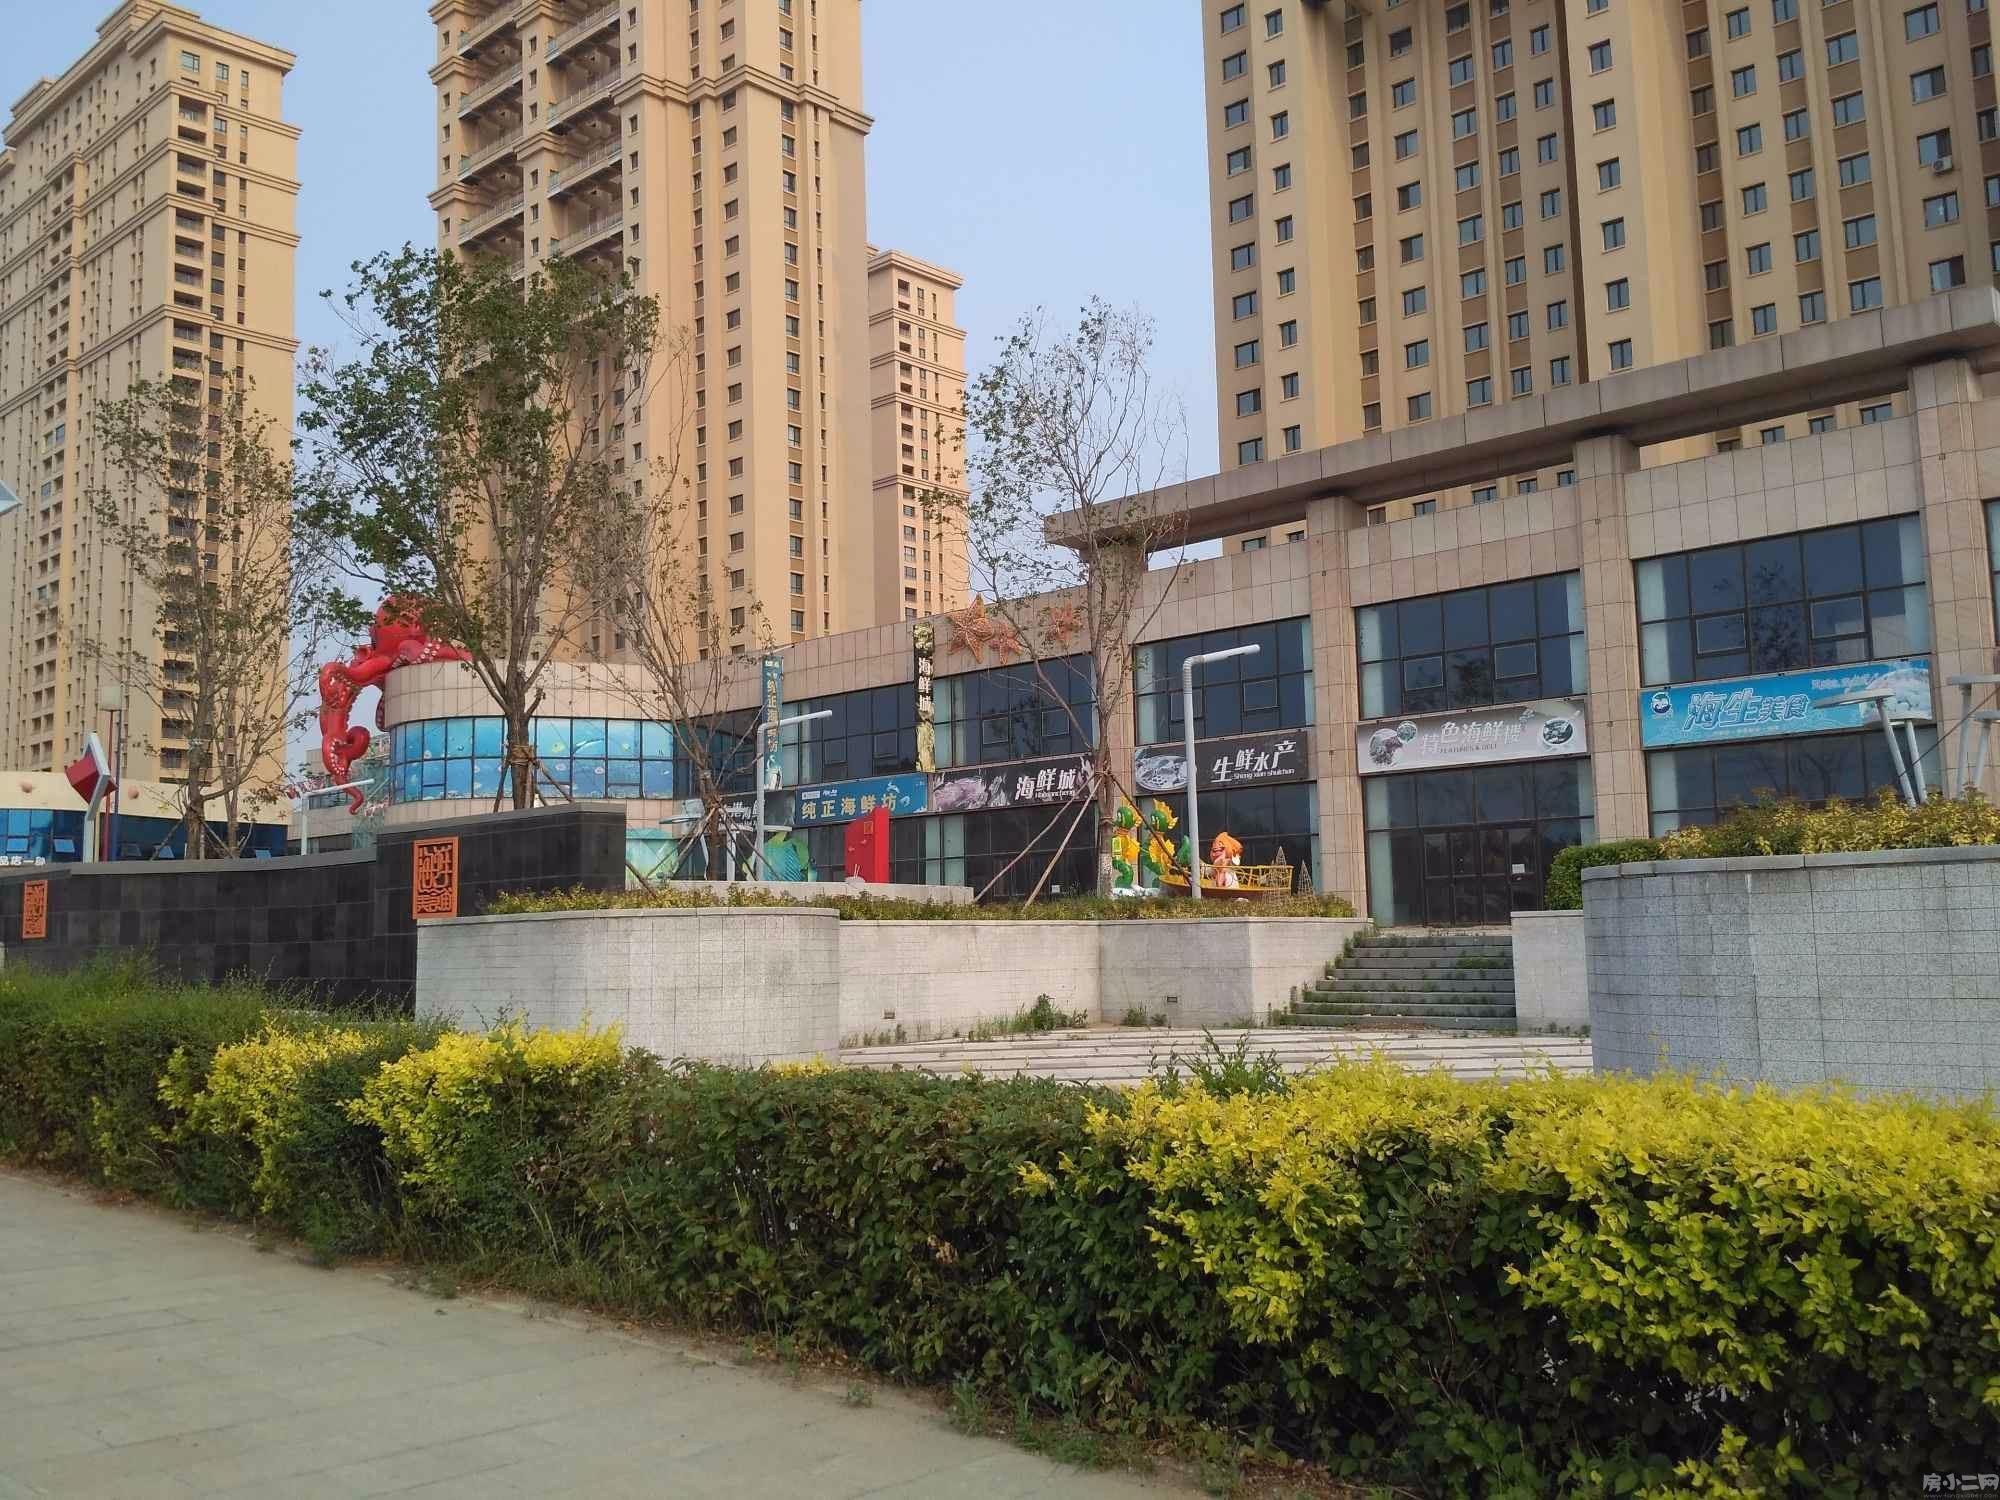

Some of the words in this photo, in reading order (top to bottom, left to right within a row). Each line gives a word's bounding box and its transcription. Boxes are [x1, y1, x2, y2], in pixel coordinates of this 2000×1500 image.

[917, 657, 933, 712] 海鲜城
[1684, 688, 1811, 731] 海生美食
[1211, 740, 1297, 783] 生鲜水产
[1014, 767, 1078, 801] 海鲜城
